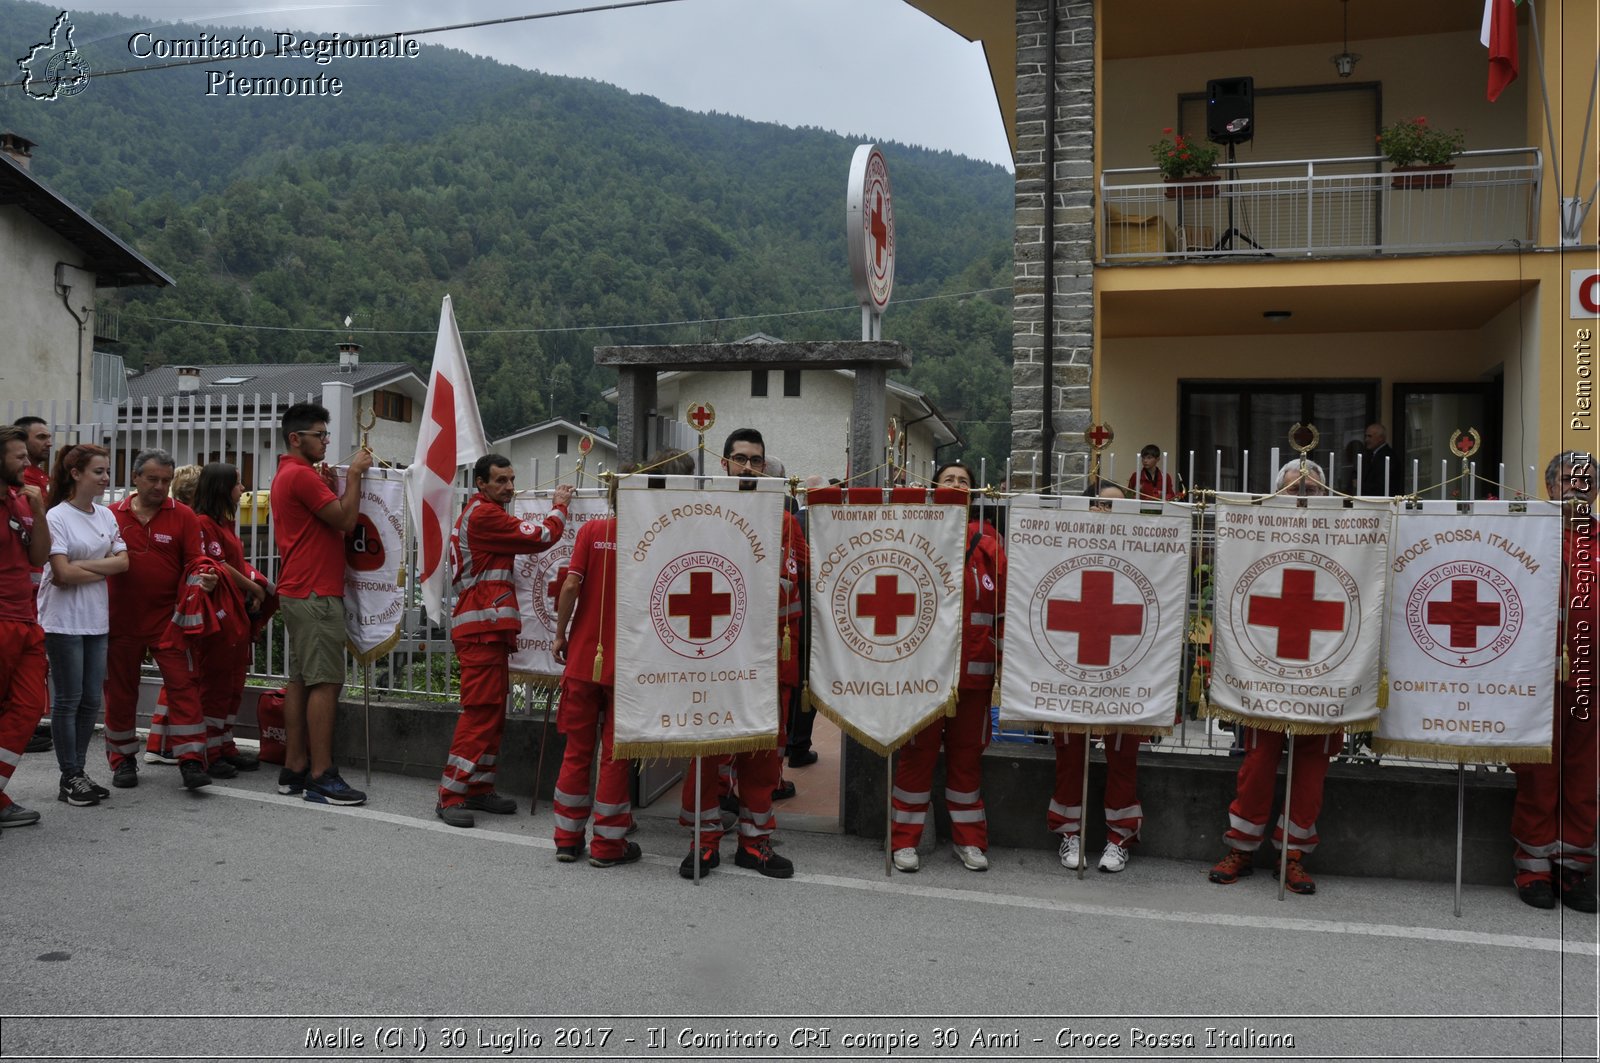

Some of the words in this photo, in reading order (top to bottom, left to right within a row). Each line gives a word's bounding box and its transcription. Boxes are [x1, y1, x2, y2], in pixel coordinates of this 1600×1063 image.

[575, 513, 587, 522] DEL
[831, 509, 877, 521] VOLONTARI
[881, 510, 898, 521] DEL
[902, 509, 945, 521] SOCCORSO
[1225, 512, 1254, 525] CORPO
[1258, 515, 1308, 529] VOLONTARI
[1312, 517, 1330, 530] DEL
[1334, 517, 1380, 530] SOCCORSO
[633, 514, 671, 563] CROCE
[671, 503, 722, 522] ROSSA
[724, 508, 766, 564] ITALIANA
[1020, 518, 1050, 531] CORPO
[1055, 521, 1105, 535] VOLONTARI
[1110, 524, 1127, 536] DEL
[1131, 526, 1179, 538] SOCCORSO
[1218, 526, 1265, 542] CROCE
[1270, 531, 1320, 544] ROSSA
[1325, 532, 1387, 545] ITALIANA
[1011, 532, 1062, 548] CROCE
[1068, 537, 1117, 551] ROSSA
[1122, 539, 1187, 555] ITALIANA
[1393, 538, 1433, 573] CROCE
[1434, 529, 1482, 545] ROSSA
[1487, 532, 1541, 575] ITALIANA
[520, 554, 538, 578] CRO
[540, 558, 549, 568] DI
[551, 547, 574, 560] GINEV
[681, 554, 725, 570] GINEVRA
[815, 543, 849, 594] CROCE
[849, 528, 905, 548] ROSSA
[909, 532, 957, 597] ITALIANA
[868, 552, 920, 574] GINEVRA
[670, 562, 681, 575] DI
[724, 564, 737, 579] 22
[850, 563, 864, 576] DI
[1236, 552, 1305, 595] CONVENZIONE
[1310, 553, 1322, 565] DI
[1324, 561, 1360, 602] GINEVRA
[1428, 570, 1442, 583] DI
[1442, 563, 1492, 580] GINEVRA
[917, 572, 930, 589] 22
[1035, 556, 1104, 600] CONVENZIONE
[1109, 556, 1120, 568] DI
[1122, 564, 1157, 606] GINEVRA
[1491, 574, 1507, 588] 22
[651, 569, 675, 644] CONVENZIONE
[733, 575, 747, 621] AGOSTO
[834, 577, 873, 656] CONVENZIONE
[917, 590, 935, 637] AGOSTO
[1408, 580, 1435, 652] CONVENZIONE
[1502, 587, 1520, 633] AGOSTO
[724, 621, 741, 643] 1864
[896, 633, 922, 657] 1864
[1491, 632, 1513, 655] 1864
[637, 671, 707, 685] COMITATO
[710, 669, 757, 682] LOCALE
[1225, 673, 1286, 694] COMITATO
[1291, 684, 1347, 698] LOCALE
[1351, 685, 1362, 696] DI
[692, 691, 707, 703] DI
[831, 679, 939, 696] SAVIGLIANO
[1031, 681, 1131, 698] DELEGAZIONE
[1137, 687, 1152, 697] DI
[1393, 680, 1470, 694] COMITATO
[1477, 682, 1537, 696] LOCALE
[1034, 696, 1145, 715] PEVERAGNO
[1241, 696, 1345, 717] RACCONIGI
[1458, 701, 1470, 711] DI
[661, 711, 734, 728] BUSCA
[1422, 718, 1506, 734] DRONERO
